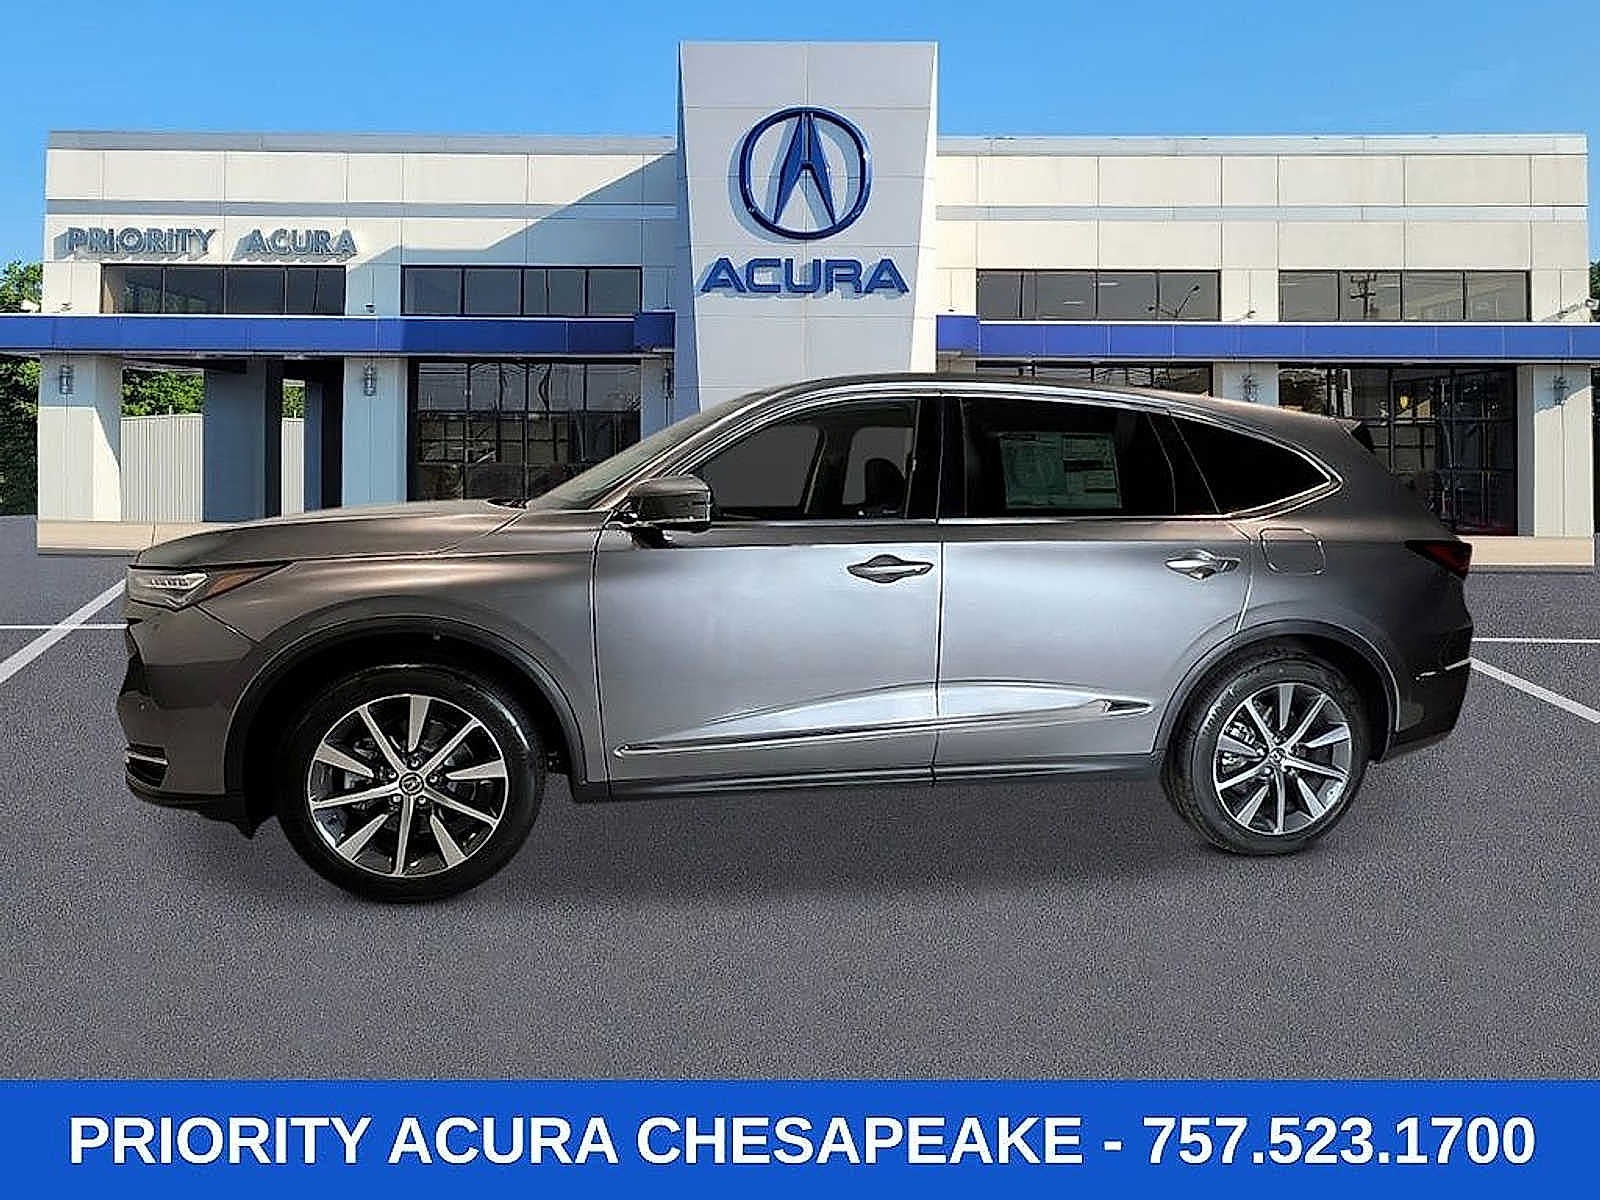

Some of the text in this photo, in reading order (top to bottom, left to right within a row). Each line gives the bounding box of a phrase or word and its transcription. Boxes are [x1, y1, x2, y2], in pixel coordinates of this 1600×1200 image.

[68, 227, 357, 255] PRIORITY ACURA
[701, 258, 909, 293] ACURA
